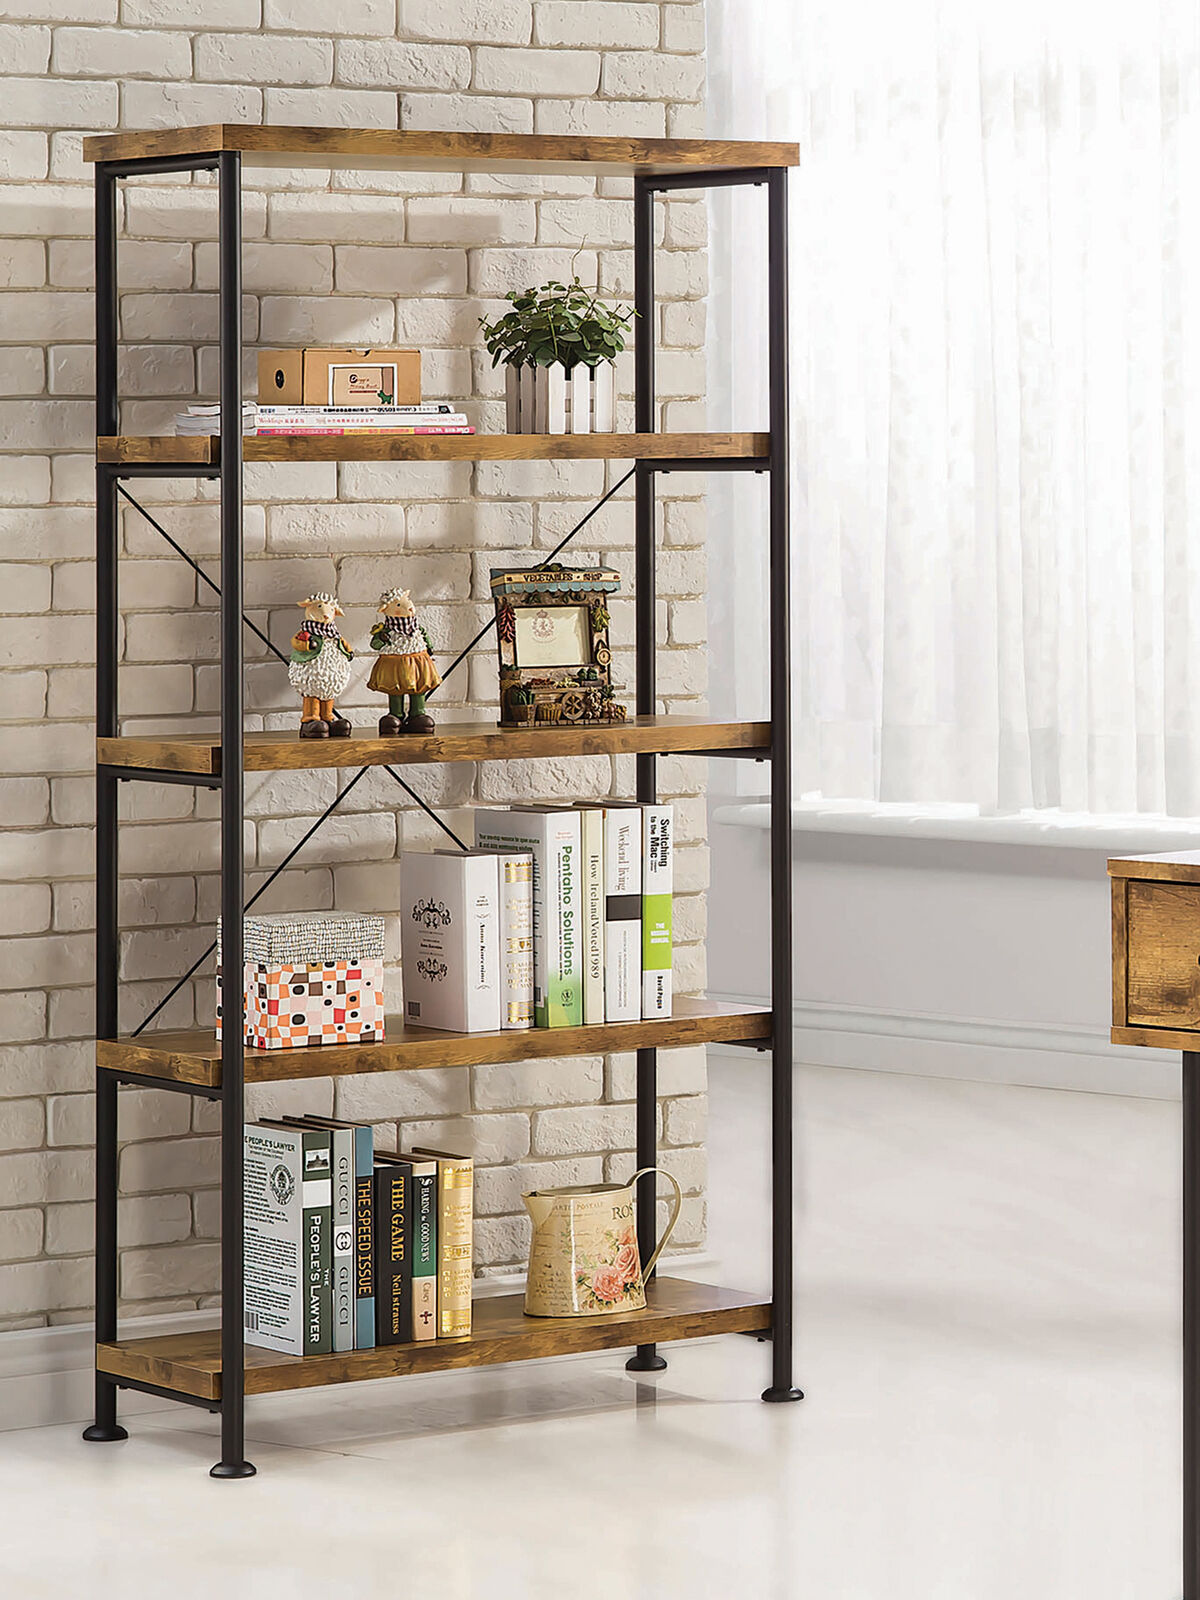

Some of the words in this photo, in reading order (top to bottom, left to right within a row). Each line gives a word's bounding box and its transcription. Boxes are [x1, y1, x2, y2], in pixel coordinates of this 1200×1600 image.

[583, 573, 603, 581] SHOP
[650, 815, 657, 823] to
[618, 825, 630, 864] Weekend
[650, 837, 660, 858] Mac
[658, 818, 670, 867] Switching
[562, 845, 573, 905] Pentaho
[590, 855, 599, 879] How
[615, 867, 630, 891] living
[563, 910, 574, 976] Solutions
[273, 1141, 296, 1152] LAWYER
[339, 1156, 348, 1215] GUCCI
[358, 1180, 371, 1207] THE
[391, 1176, 405, 1211] THE
[310, 1215, 322, 1282] PEOPLE'S
[358, 1209, 372, 1252] SPEED
[391, 1213, 405, 1262] GAME
[358, 1254, 372, 1295] ISSUE
[310, 1285, 321, 1343] LAWYER
[339, 1267, 349, 1325] GUCCI
[392, 1297, 401, 1335] strauss
